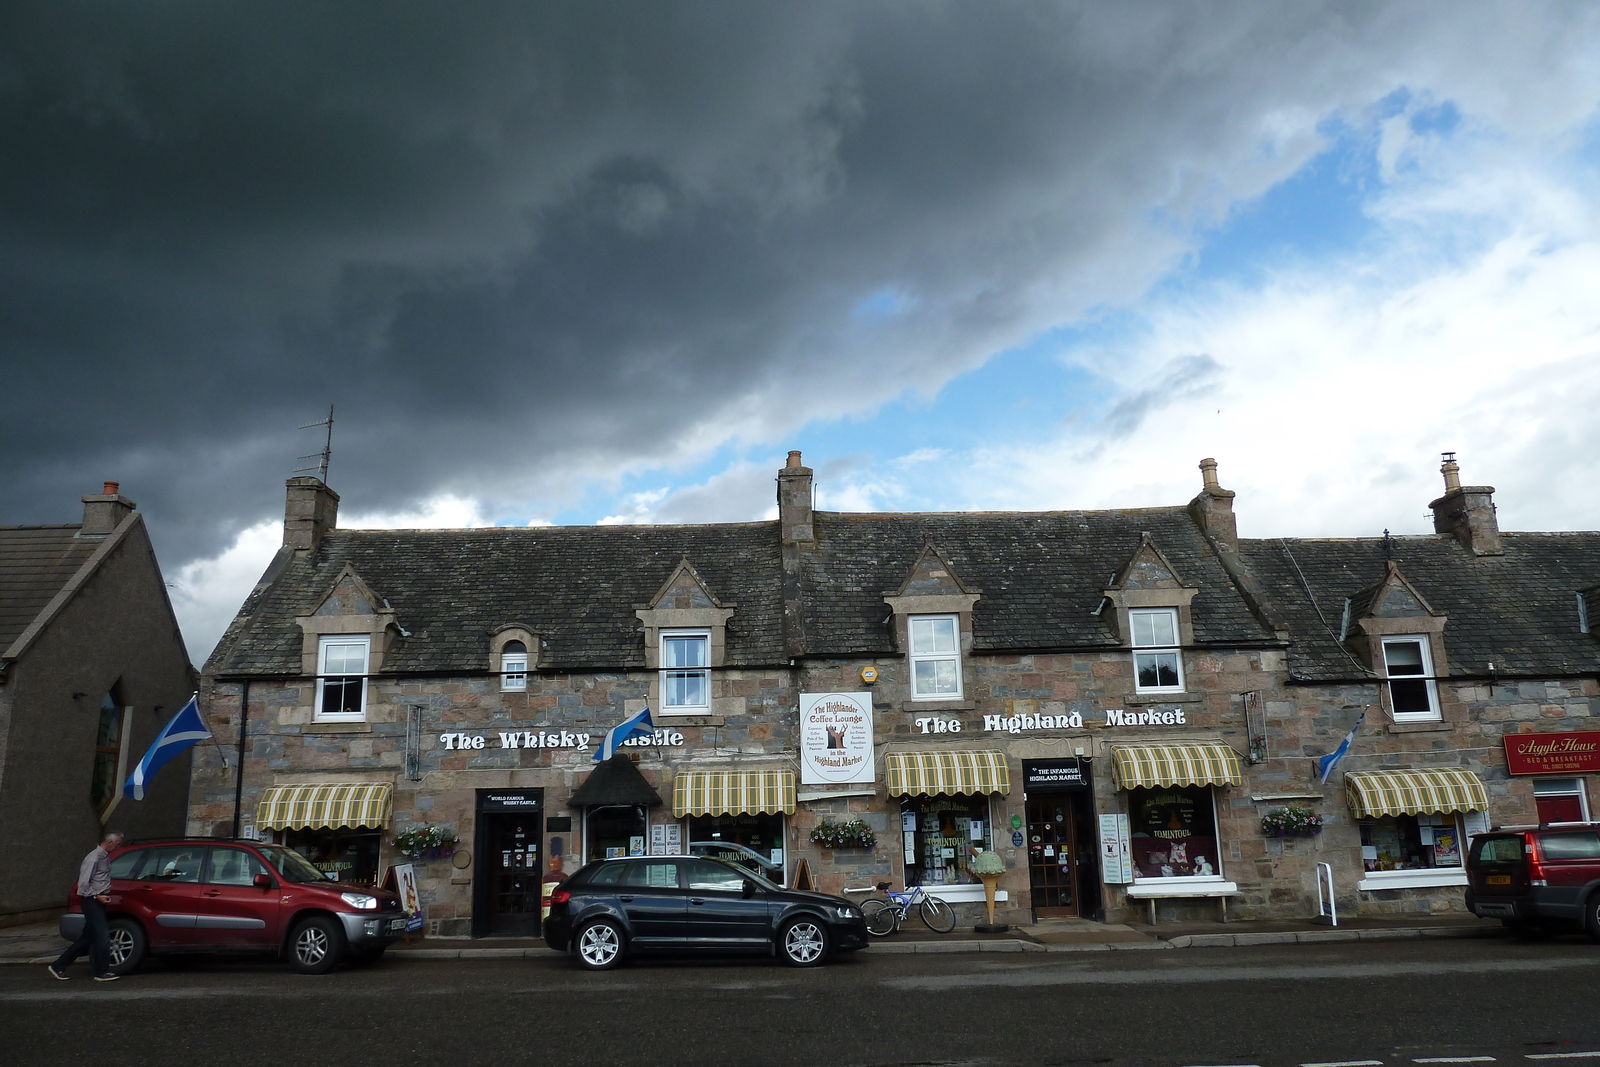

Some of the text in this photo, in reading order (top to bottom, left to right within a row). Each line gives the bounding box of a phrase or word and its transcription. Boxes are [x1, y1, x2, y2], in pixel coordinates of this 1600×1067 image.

[815, 701, 858, 715] The Highlander
[810, 714, 863, 724] Coffee Lounge
[915, 708, 1187, 735] The Highland Market
[440, 729, 684, 751] The Whisky astle
[1517, 738, 1598, 757] Argyle House
[815, 755, 863, 767] Highland Market
[1550, 755, 1592, 763] BREAKFAST
[1153, 829, 1192, 839] TOMINTOUL
